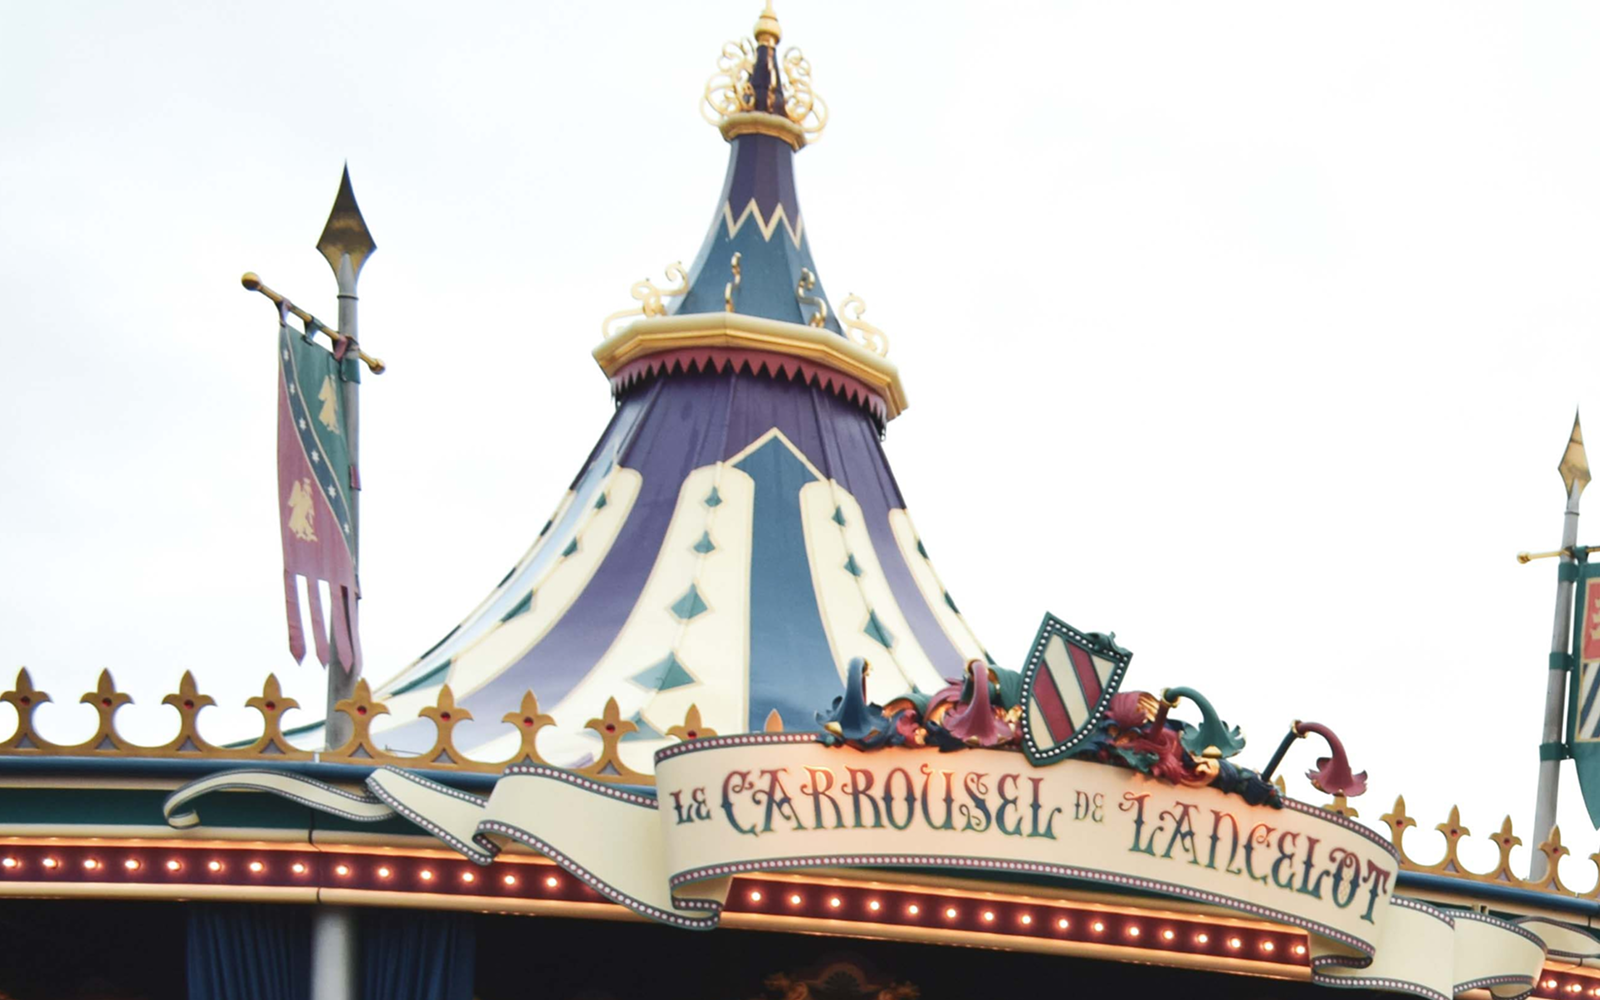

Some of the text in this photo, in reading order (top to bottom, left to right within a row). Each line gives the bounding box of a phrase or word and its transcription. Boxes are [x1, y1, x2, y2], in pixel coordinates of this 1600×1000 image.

[669, 763, 1391, 925] LE CARROUSEL DE LANCELOT
